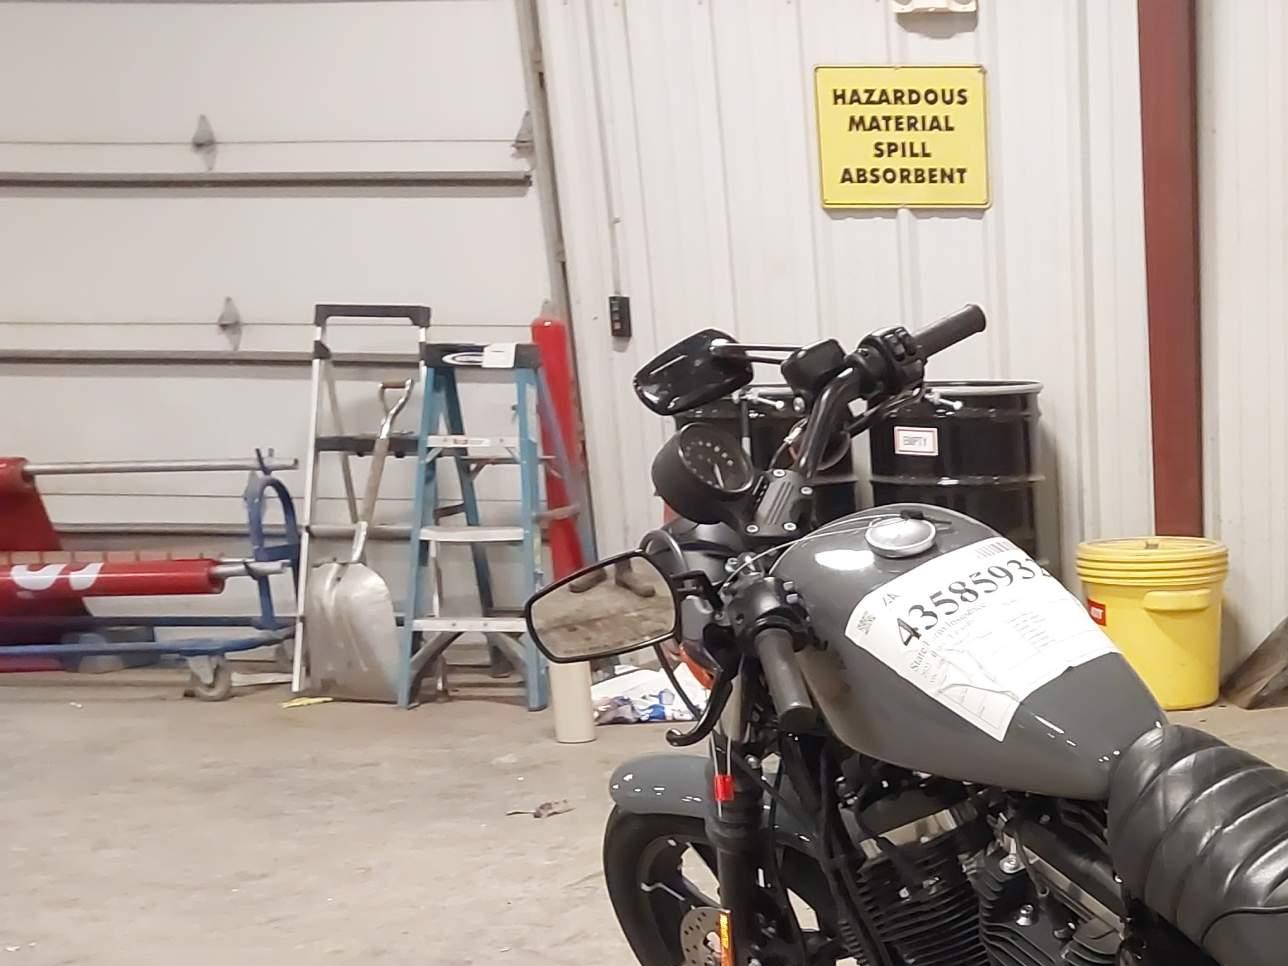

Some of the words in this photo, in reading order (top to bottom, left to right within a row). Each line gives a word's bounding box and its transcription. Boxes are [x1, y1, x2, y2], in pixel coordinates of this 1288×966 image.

[833, 88, 968, 106] HAZARDOUS
[848, 115, 955, 132] MATERIAL
[873, 141, 932, 158] SPILL
[839, 168, 968, 184] ABSORBENT
